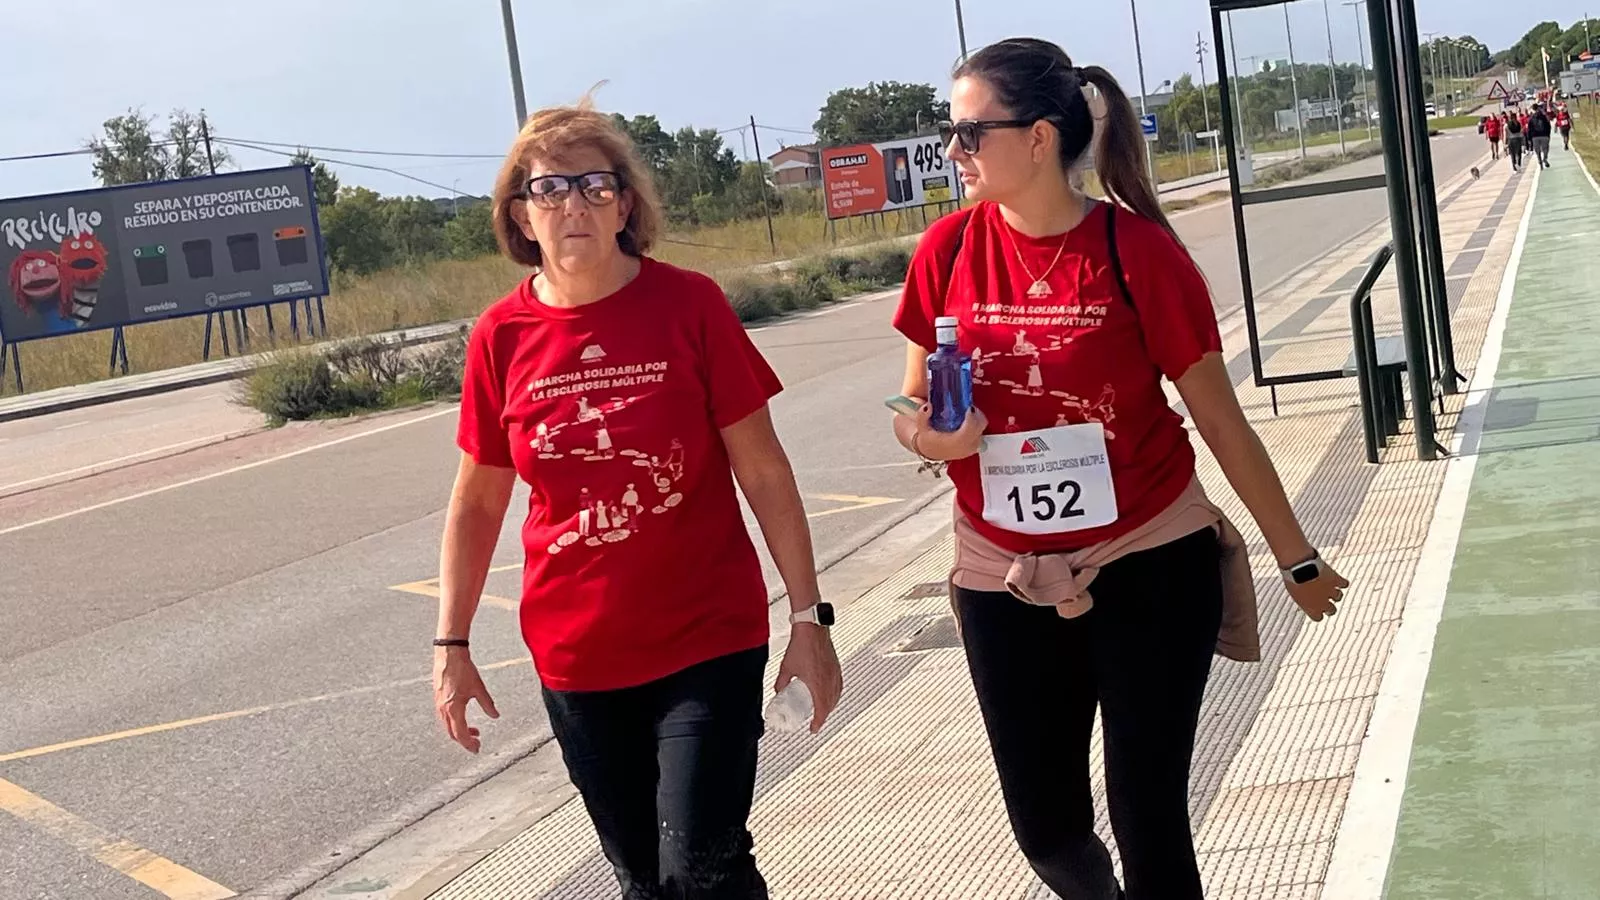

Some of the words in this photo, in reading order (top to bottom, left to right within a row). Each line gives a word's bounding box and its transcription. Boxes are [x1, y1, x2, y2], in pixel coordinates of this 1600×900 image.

[830, 155, 867, 168] OBRAMAT
[914, 142, 943, 173] 495
[124, 212, 179, 229] RESIDUO
[180, 209, 198, 221] EN
[199, 206, 216, 219] SU
[216, 196, 303, 217] CONTENEDOR.
[134, 198, 182, 214] SEPARA
[183, 195, 192, 208] Y
[193, 189, 254, 207] DEPOSITA
[254, 185, 290, 199] CADA
[973, 314, 987, 324] LA
[988, 315, 1051, 326] ESCLEROSIS
[1051, 315, 1103, 327] MÚLTIPLE
[980, 303, 1025, 314] MARCHA
[1026, 305, 1082, 315] SOLIDARIA
[1084, 305, 1107, 316] POR
[531, 390, 545, 402] LA
[546, 379, 610, 398] ESCLEROSIS
[611, 373, 664, 388] MÚLTIPLE
[534, 371, 582, 389] MARCHA
[583, 364, 643, 379] SOLIDARIA
[644, 361, 668, 373] POR
[1007, 480, 1085, 522] 152
